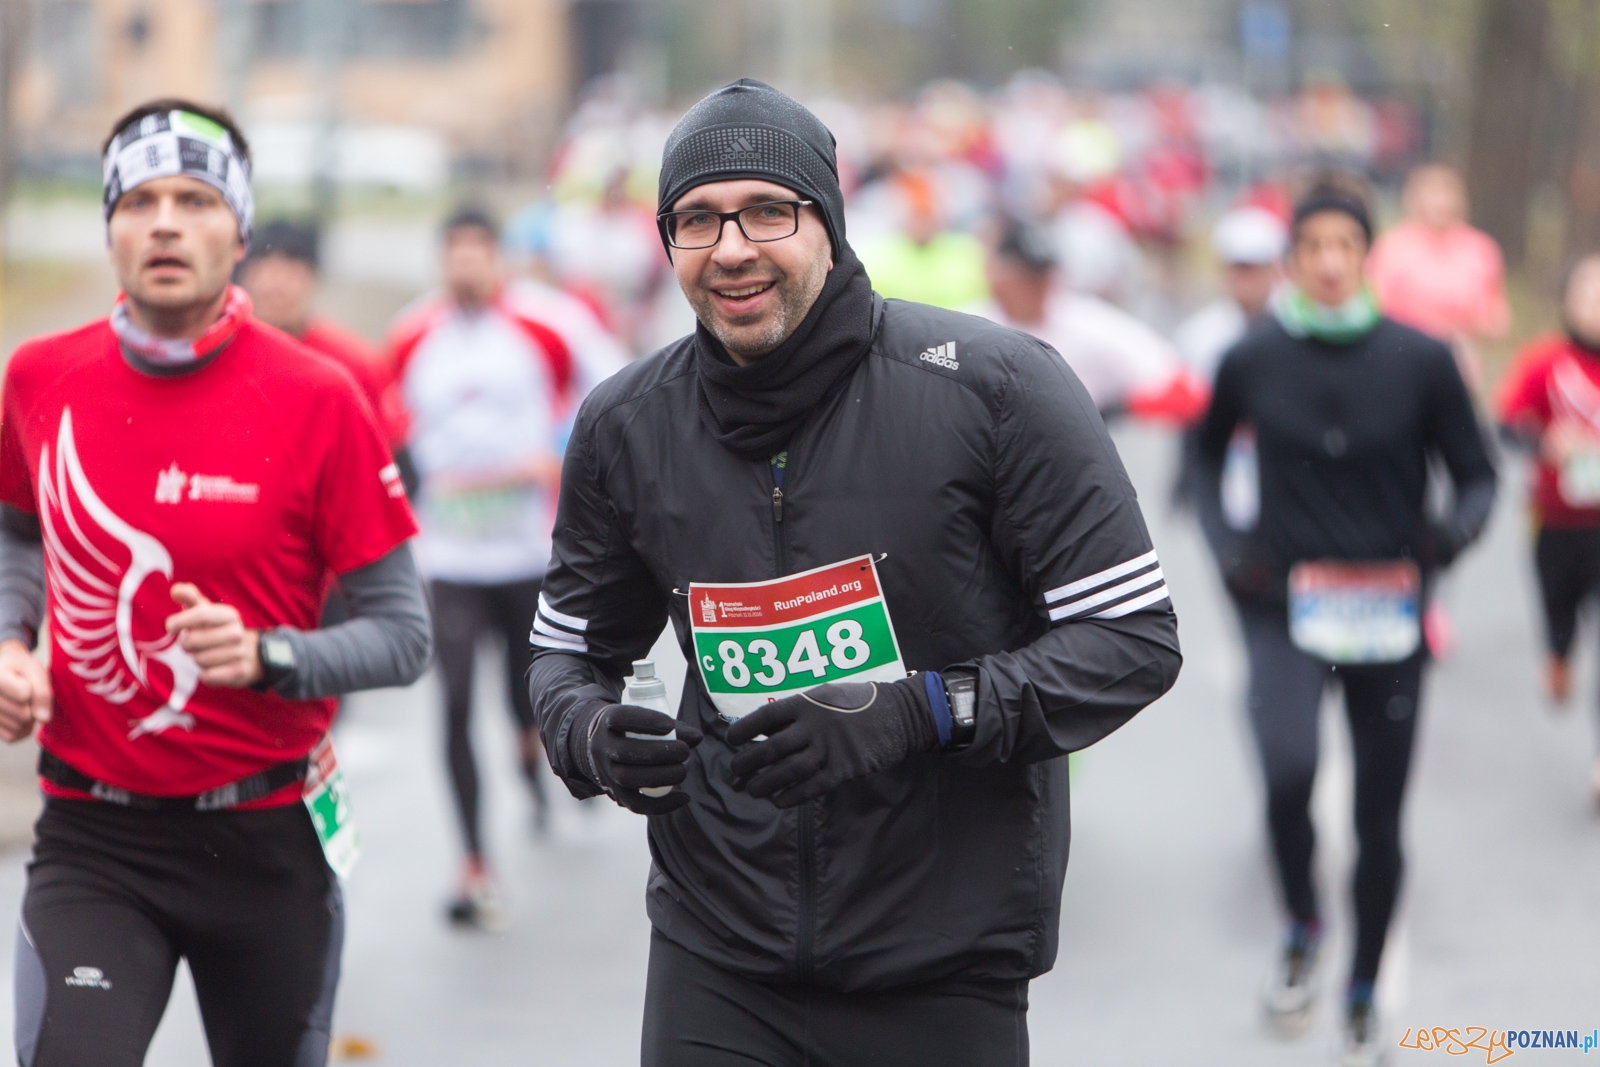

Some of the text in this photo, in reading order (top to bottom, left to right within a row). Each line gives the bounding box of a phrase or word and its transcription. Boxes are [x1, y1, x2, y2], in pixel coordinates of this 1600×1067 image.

[720, 150, 761, 160] adidas
[919, 352, 960, 370] adidas
[773, 580, 862, 611] RunPoland.org
[719, 601, 728, 618] 1
[717, 619, 871, 689] 8348
